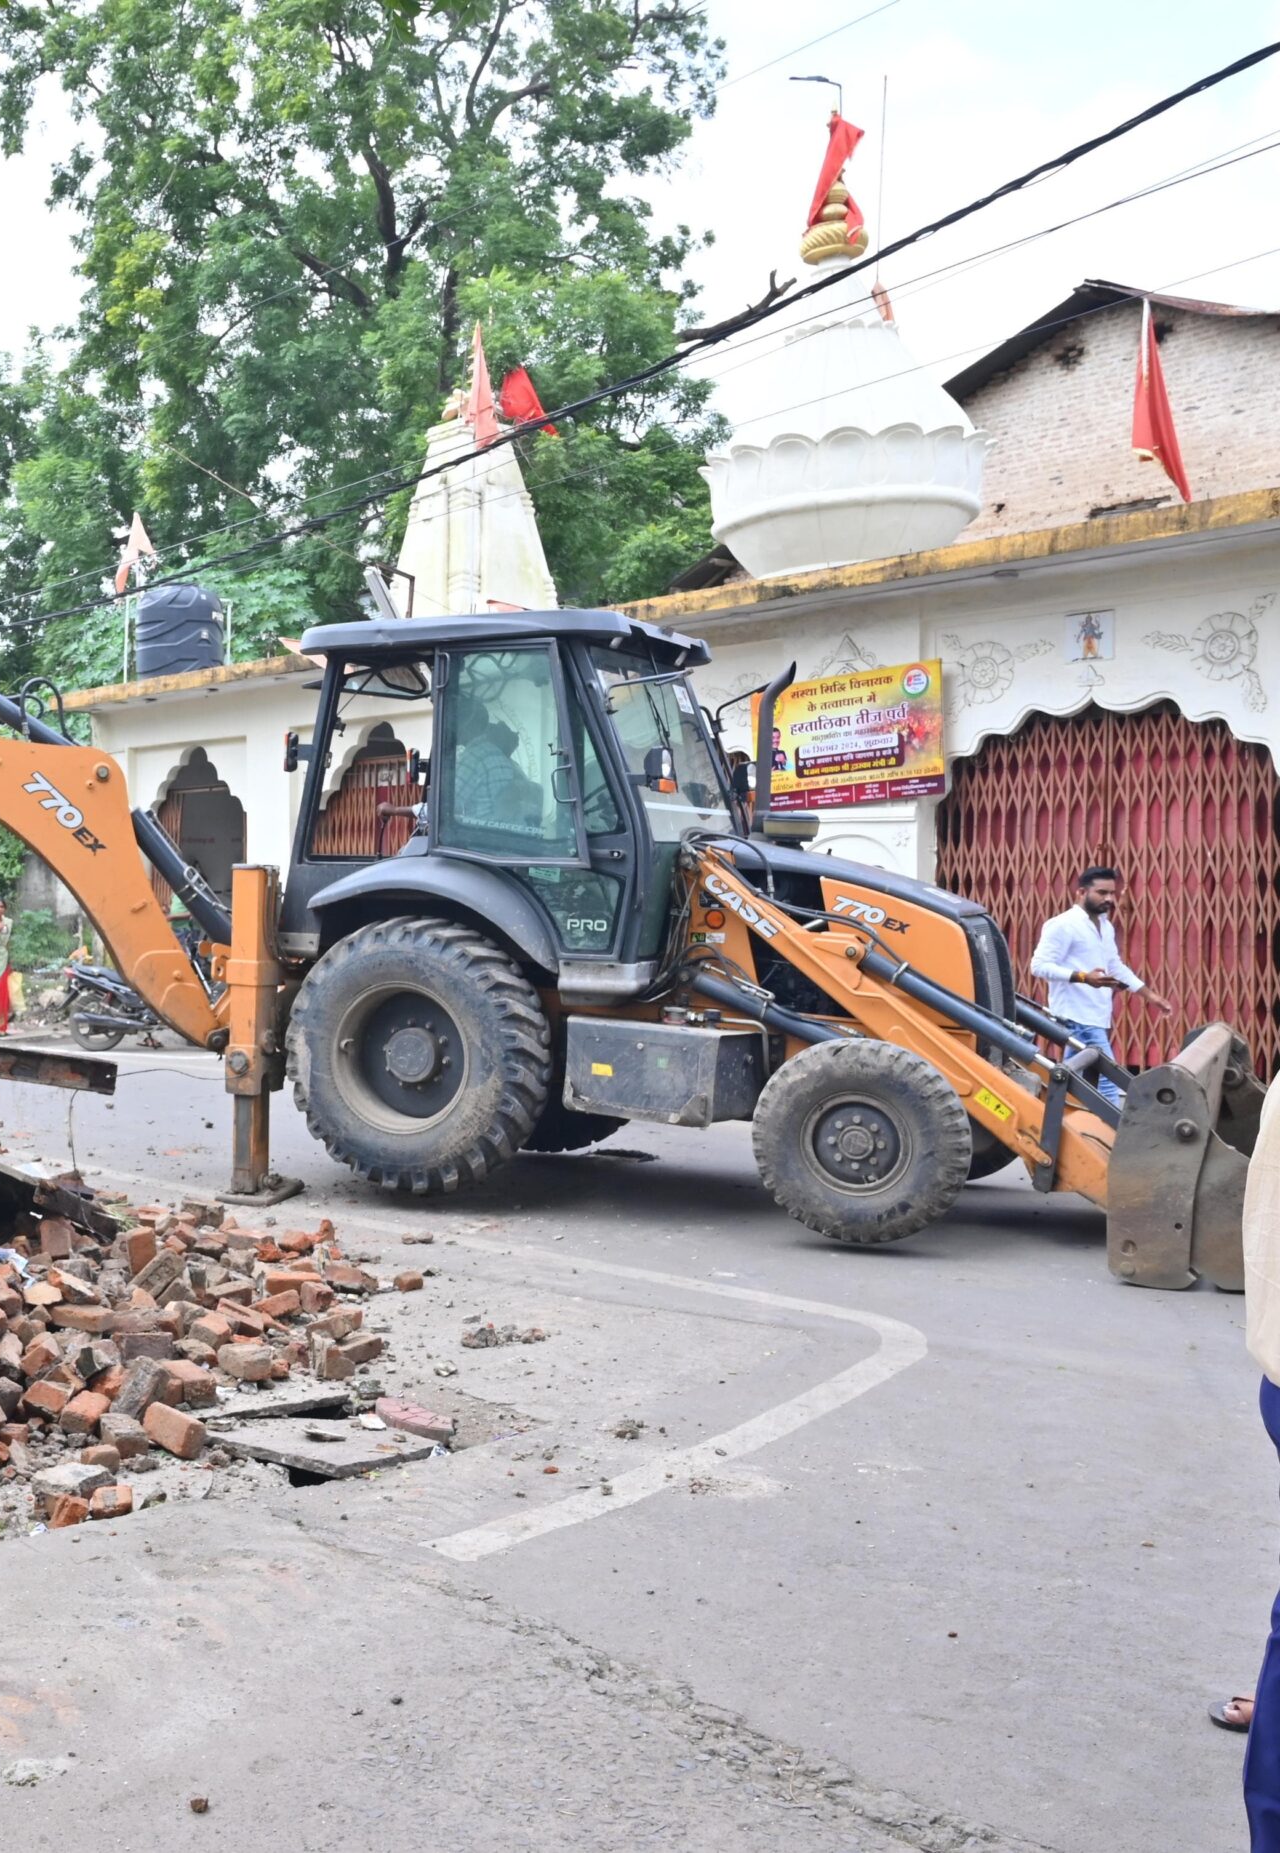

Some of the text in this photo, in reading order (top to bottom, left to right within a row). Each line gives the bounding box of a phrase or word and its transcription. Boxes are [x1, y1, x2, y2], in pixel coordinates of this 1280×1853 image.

[790, 676, 893, 699] संस्था सिद्धि विनायक
[807, 691, 876, 712] के तत्वाधान में
[789, 702, 908, 736] हरतालिका तीज पर्व
[704, 873, 779, 938] CASE
[566, 918, 608, 932] PRO
